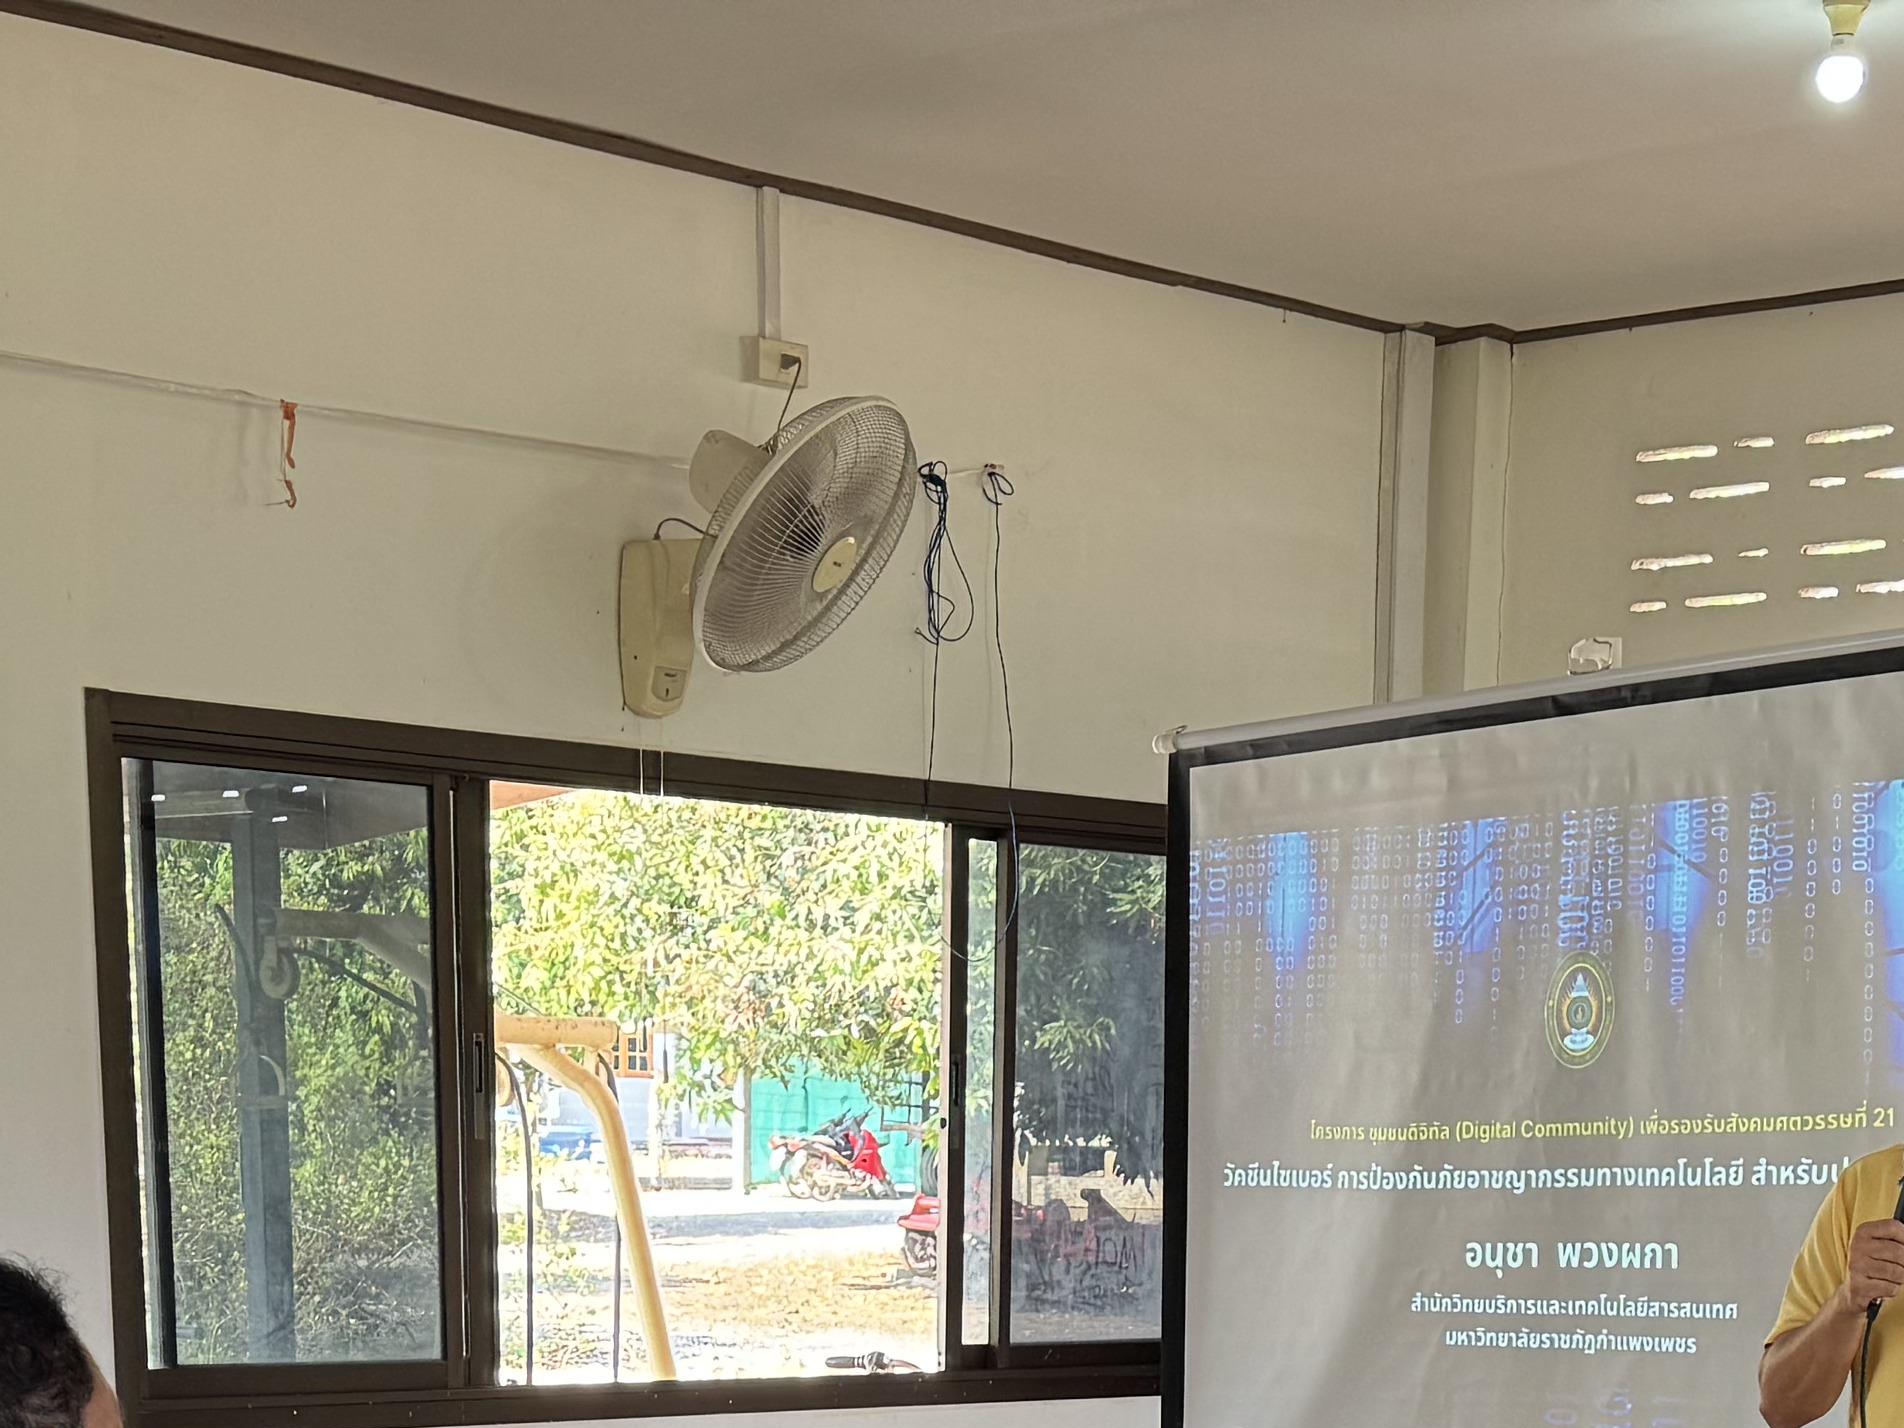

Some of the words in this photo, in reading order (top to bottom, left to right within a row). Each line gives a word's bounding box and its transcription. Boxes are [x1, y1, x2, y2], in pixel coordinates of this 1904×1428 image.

[1310, 1119, 1365, 1141] โครงการ
[1369, 1120, 1450, 1146] ชุมชนดิจิทัล
[1456, 1119, 1516, 1144] (Digital
[1521, 1115, 1634, 1140] Community)
[1640, 1099, 1867, 1136] เพื่อรองรับสังคมศตวรรษที่
[1873, 1107, 1895, 1128] 21
[1223, 1160, 1333, 1188] วัคซีนไซเบอร์
[1337, 1157, 1743, 1194] การป้องกันภัยอาชญากรรมทางเทคโนโลยี
[1465, 1241, 1539, 1279] อนุชา
[1557, 1241, 1679, 1270] พวงผกา
[1411, 1291, 1738, 1320] สำนักวิทยบริการและเทคโนโลยีสารสนเทศ
[1445, 1327, 1697, 1355] มหาวิทยาลัยราชภัฏกำแพงเพชร
